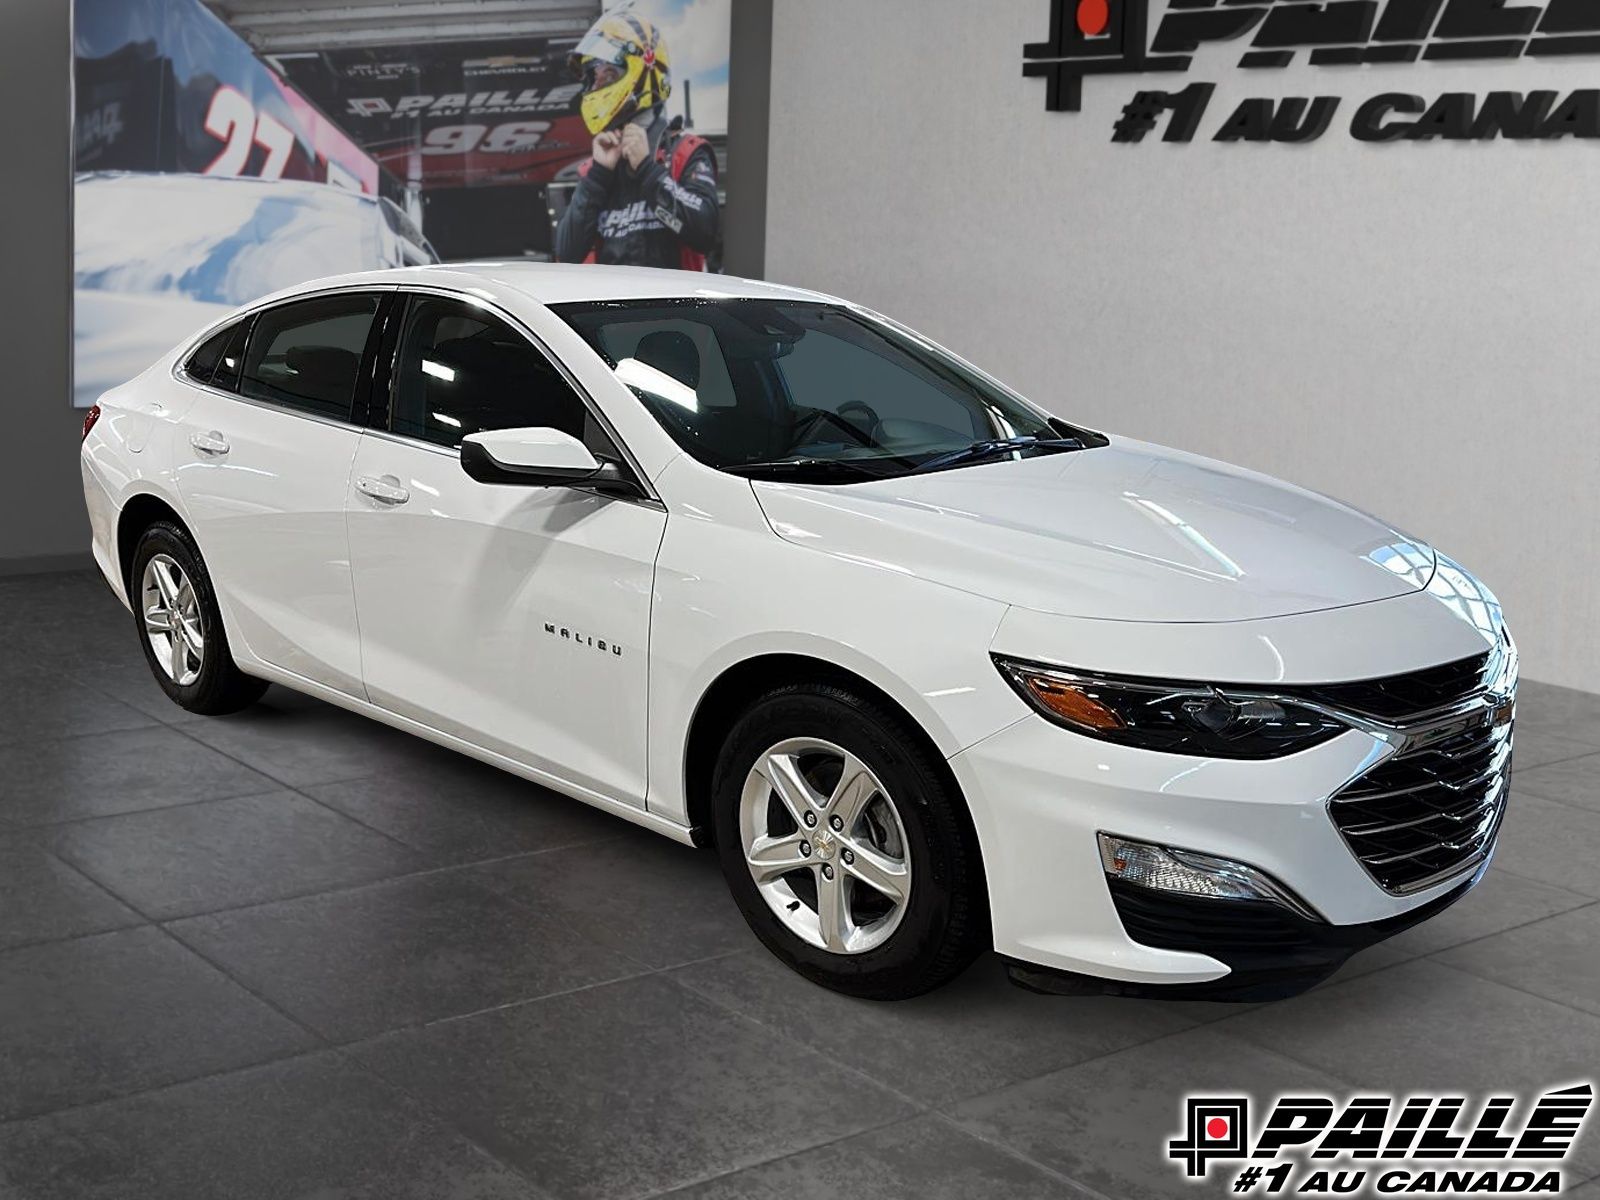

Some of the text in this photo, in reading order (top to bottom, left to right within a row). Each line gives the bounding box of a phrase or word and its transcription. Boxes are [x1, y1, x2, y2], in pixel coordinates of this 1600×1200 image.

[427, 108, 461, 117] AU
[466, 103, 570, 115] CANADA
[1111, 82, 1217, 142] #1
[1212, 96, 1342, 142] AU
[203, 84, 295, 182] 27
[422, 121, 551, 155] 96
[544, 623, 622, 656] MALIBU
